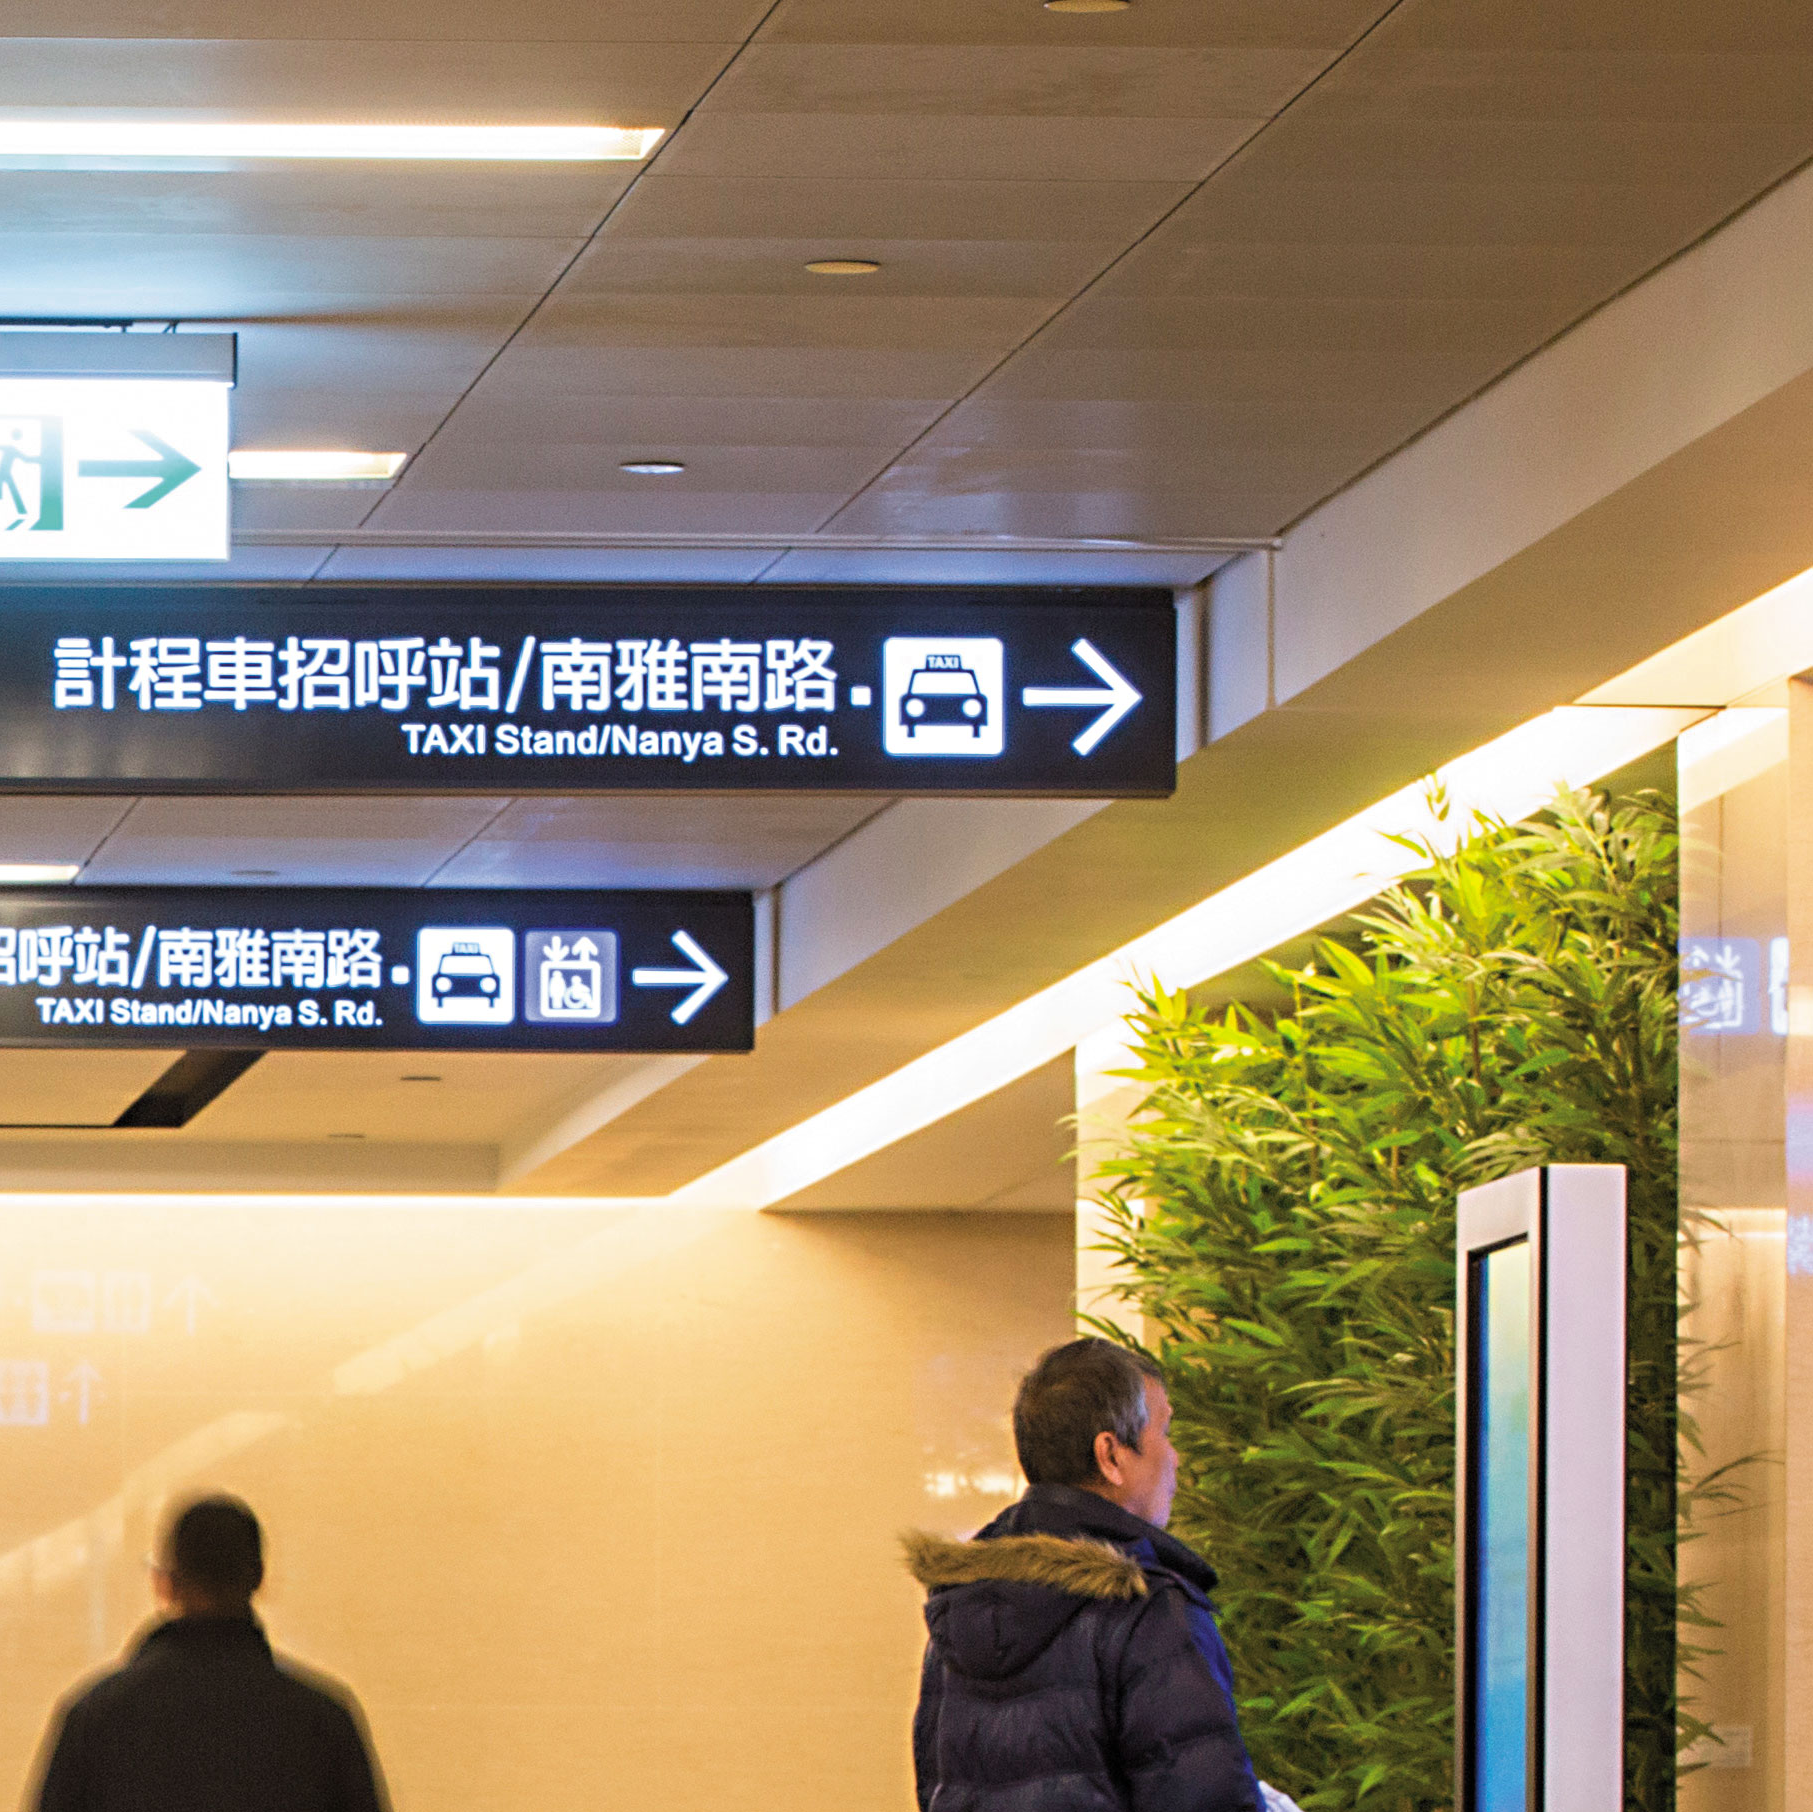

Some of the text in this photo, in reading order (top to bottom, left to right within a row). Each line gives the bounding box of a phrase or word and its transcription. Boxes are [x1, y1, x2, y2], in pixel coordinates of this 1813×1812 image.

[926, 656, 960, 669] TAXI
[401, 724, 838, 762] TAXI Stand/Nanya S. Rd.
[35, 997, 383, 1030] TAXI Stand/Nanya S. Rd.
